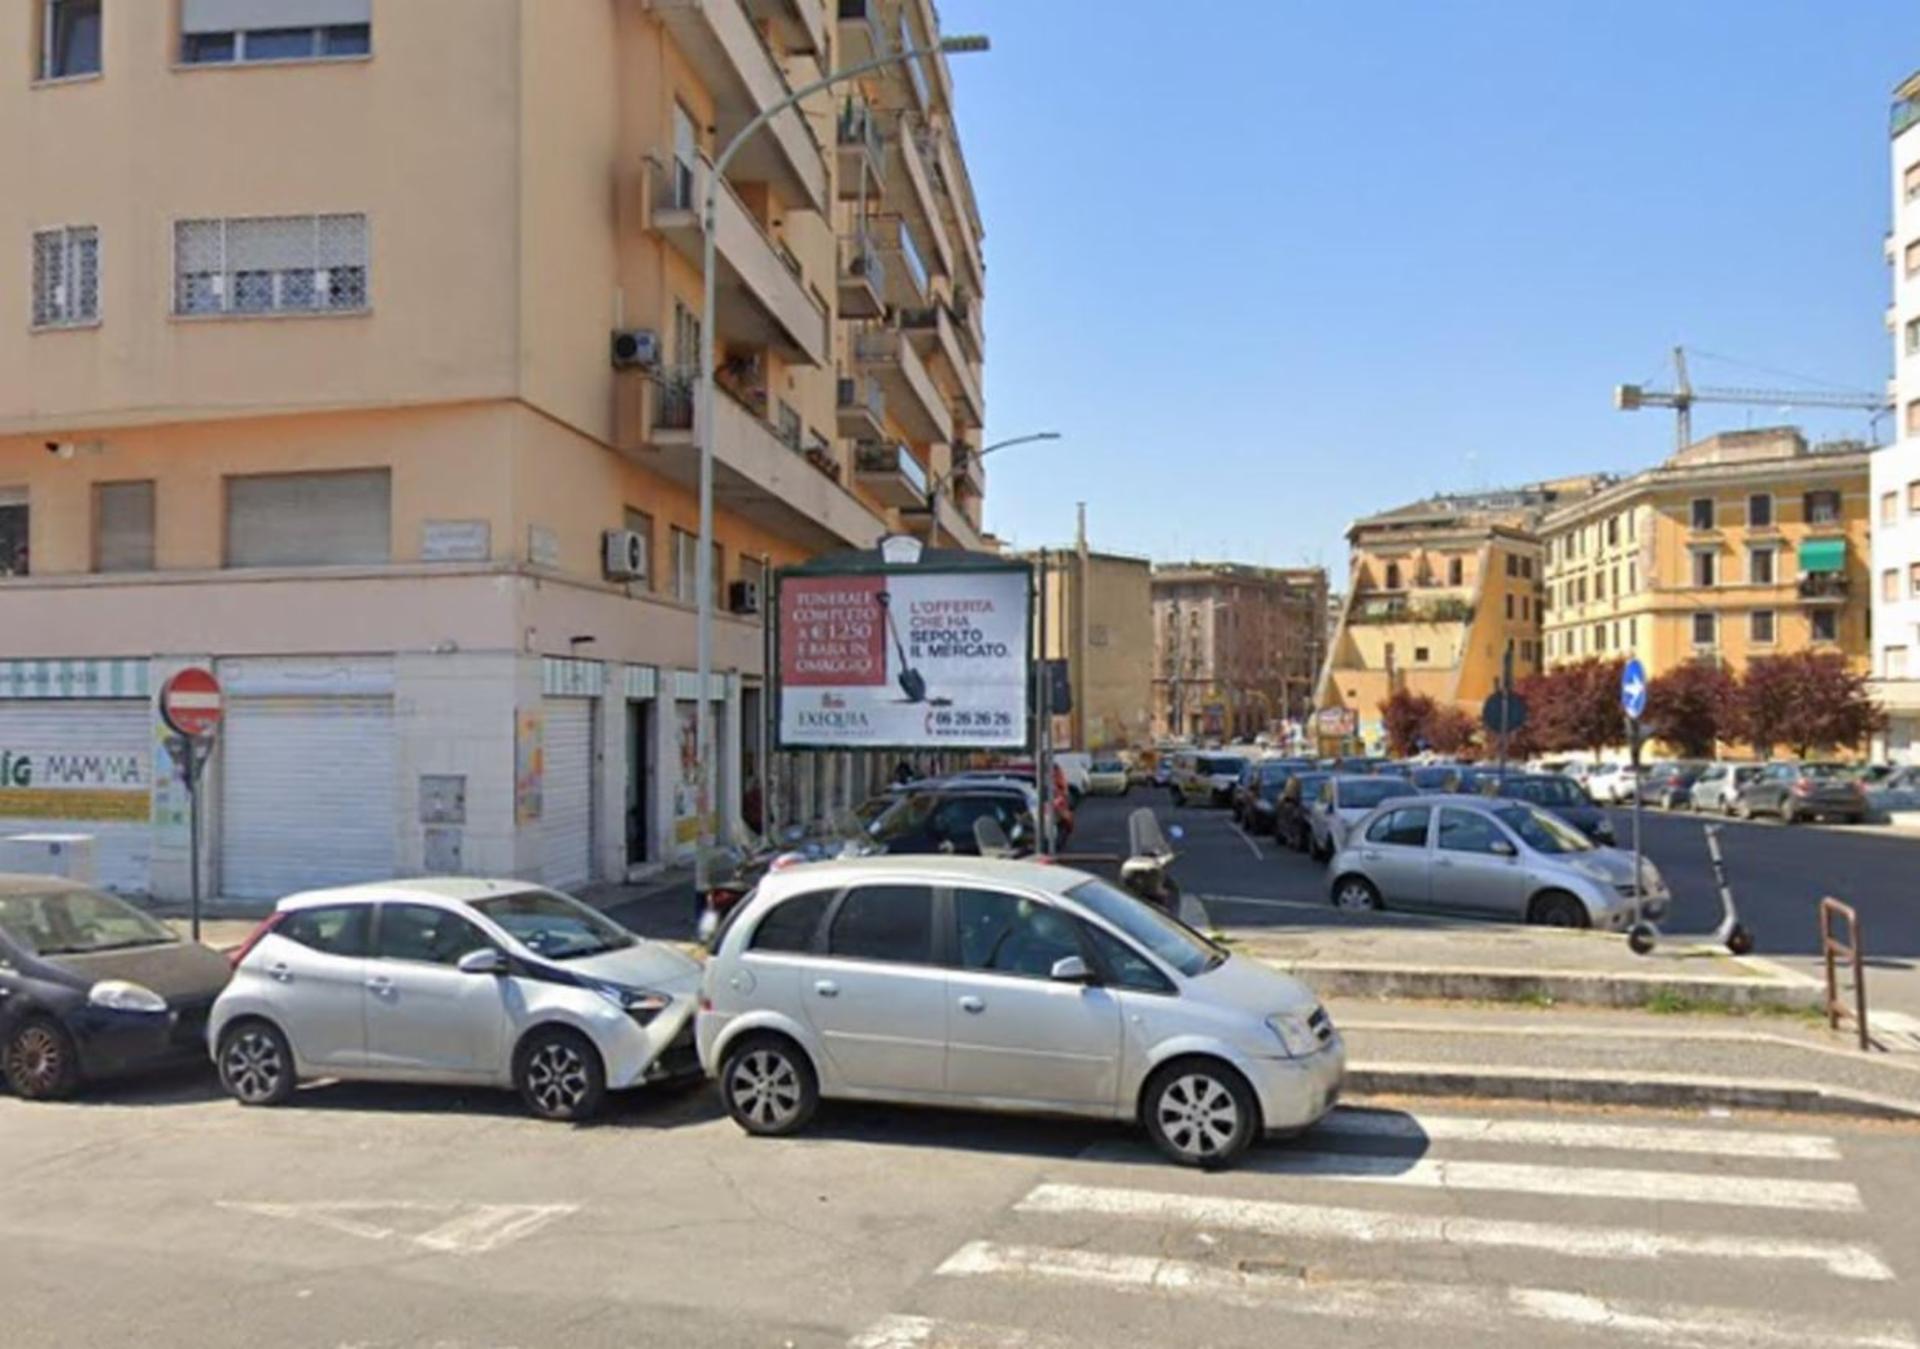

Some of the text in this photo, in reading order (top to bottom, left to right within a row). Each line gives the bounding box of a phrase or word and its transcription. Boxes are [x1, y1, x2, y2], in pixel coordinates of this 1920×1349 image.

[910, 600, 994, 614] L'OFFERTA
[792, 608, 877, 622] COMPLETO
[910, 628, 984, 643] SEPOLTO
[45, 756, 140, 783] MAMMA
